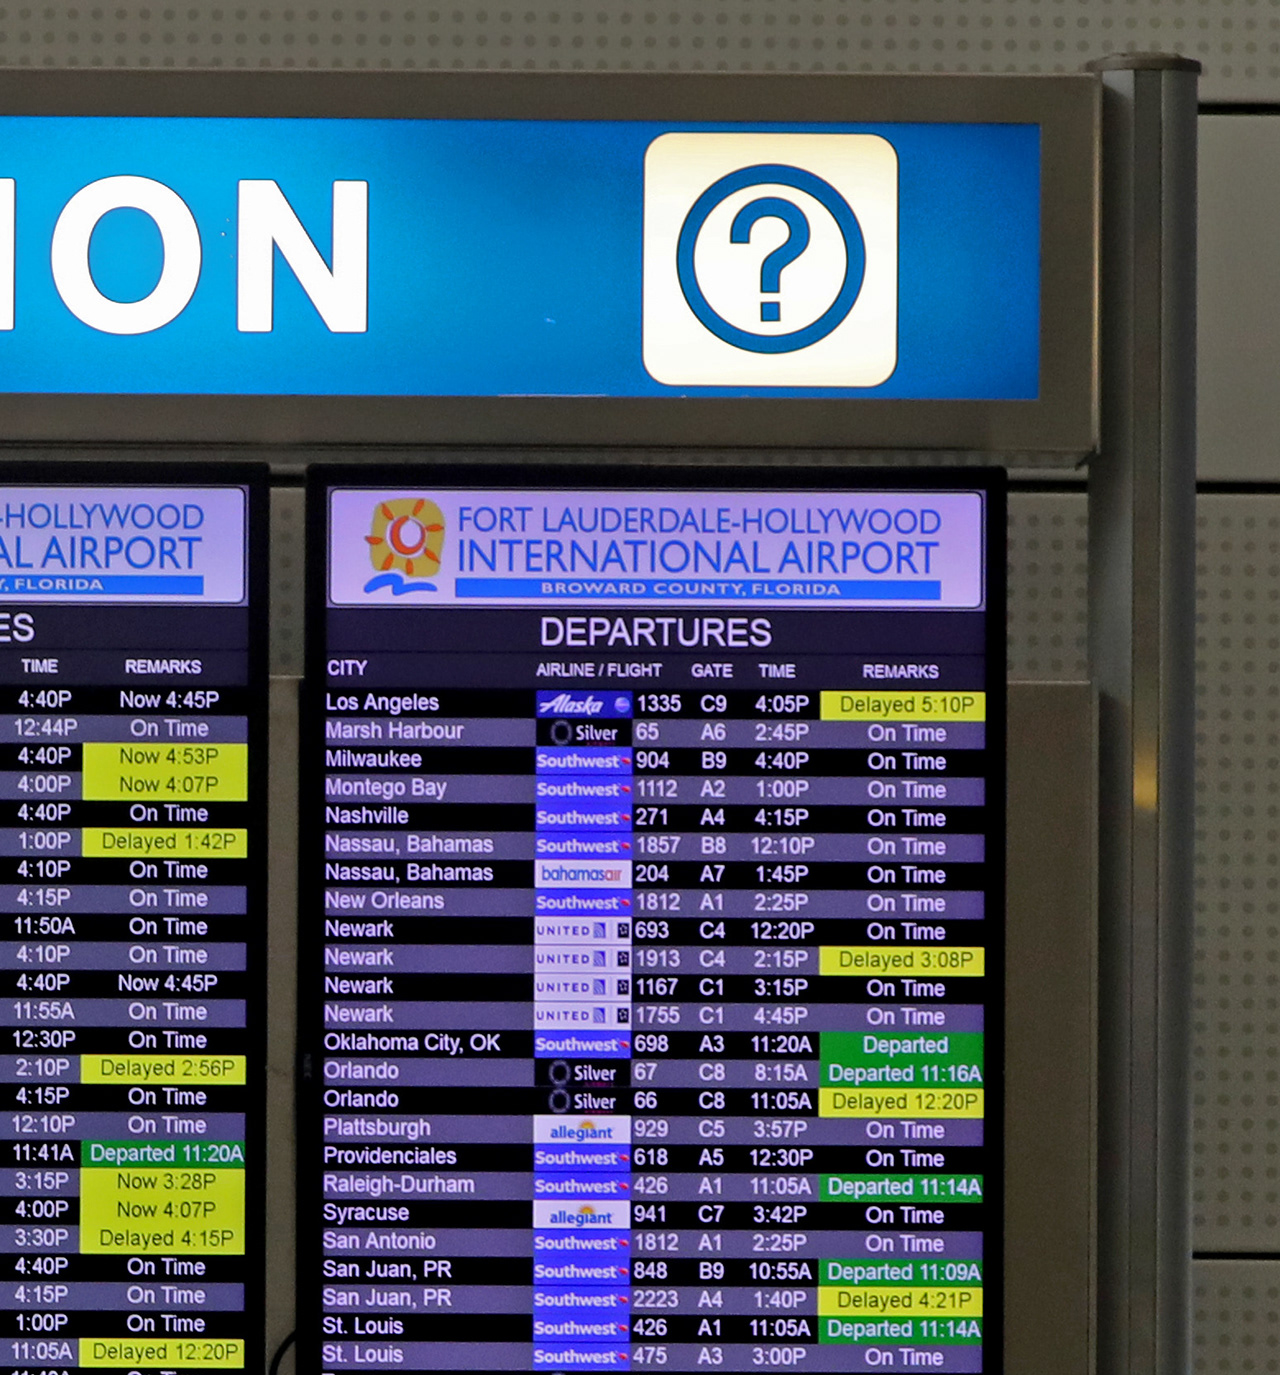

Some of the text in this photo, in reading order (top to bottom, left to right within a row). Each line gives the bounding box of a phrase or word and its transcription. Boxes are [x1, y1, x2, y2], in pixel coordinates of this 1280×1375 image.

[459, 507, 941, 534] FORT LAUDERDALE-HOLLYWOOD
[42, 536, 202, 568] AIRPORT
[460, 539, 939, 573] INTERNATIONAL AIRPORT
[12, 577, 104, 592] FLORIDA
[538, 582, 841, 597] BROWARD COUNTY, FLORIDA
[542, 616, 771, 647] DEPARTURES
[20, 657, 59, 676] TIME
[124, 658, 203, 676] REMARKS
[14, 1144, 73, 1160] 11:41A
[88, 1144, 177, 1166] Departed
[181, 1144, 245, 1164] 11:20A
[16, 1172, 68, 1189] 3:15P
[118, 1173, 157, 1189] Now
[164, 1173, 216, 1189] 3:28P
